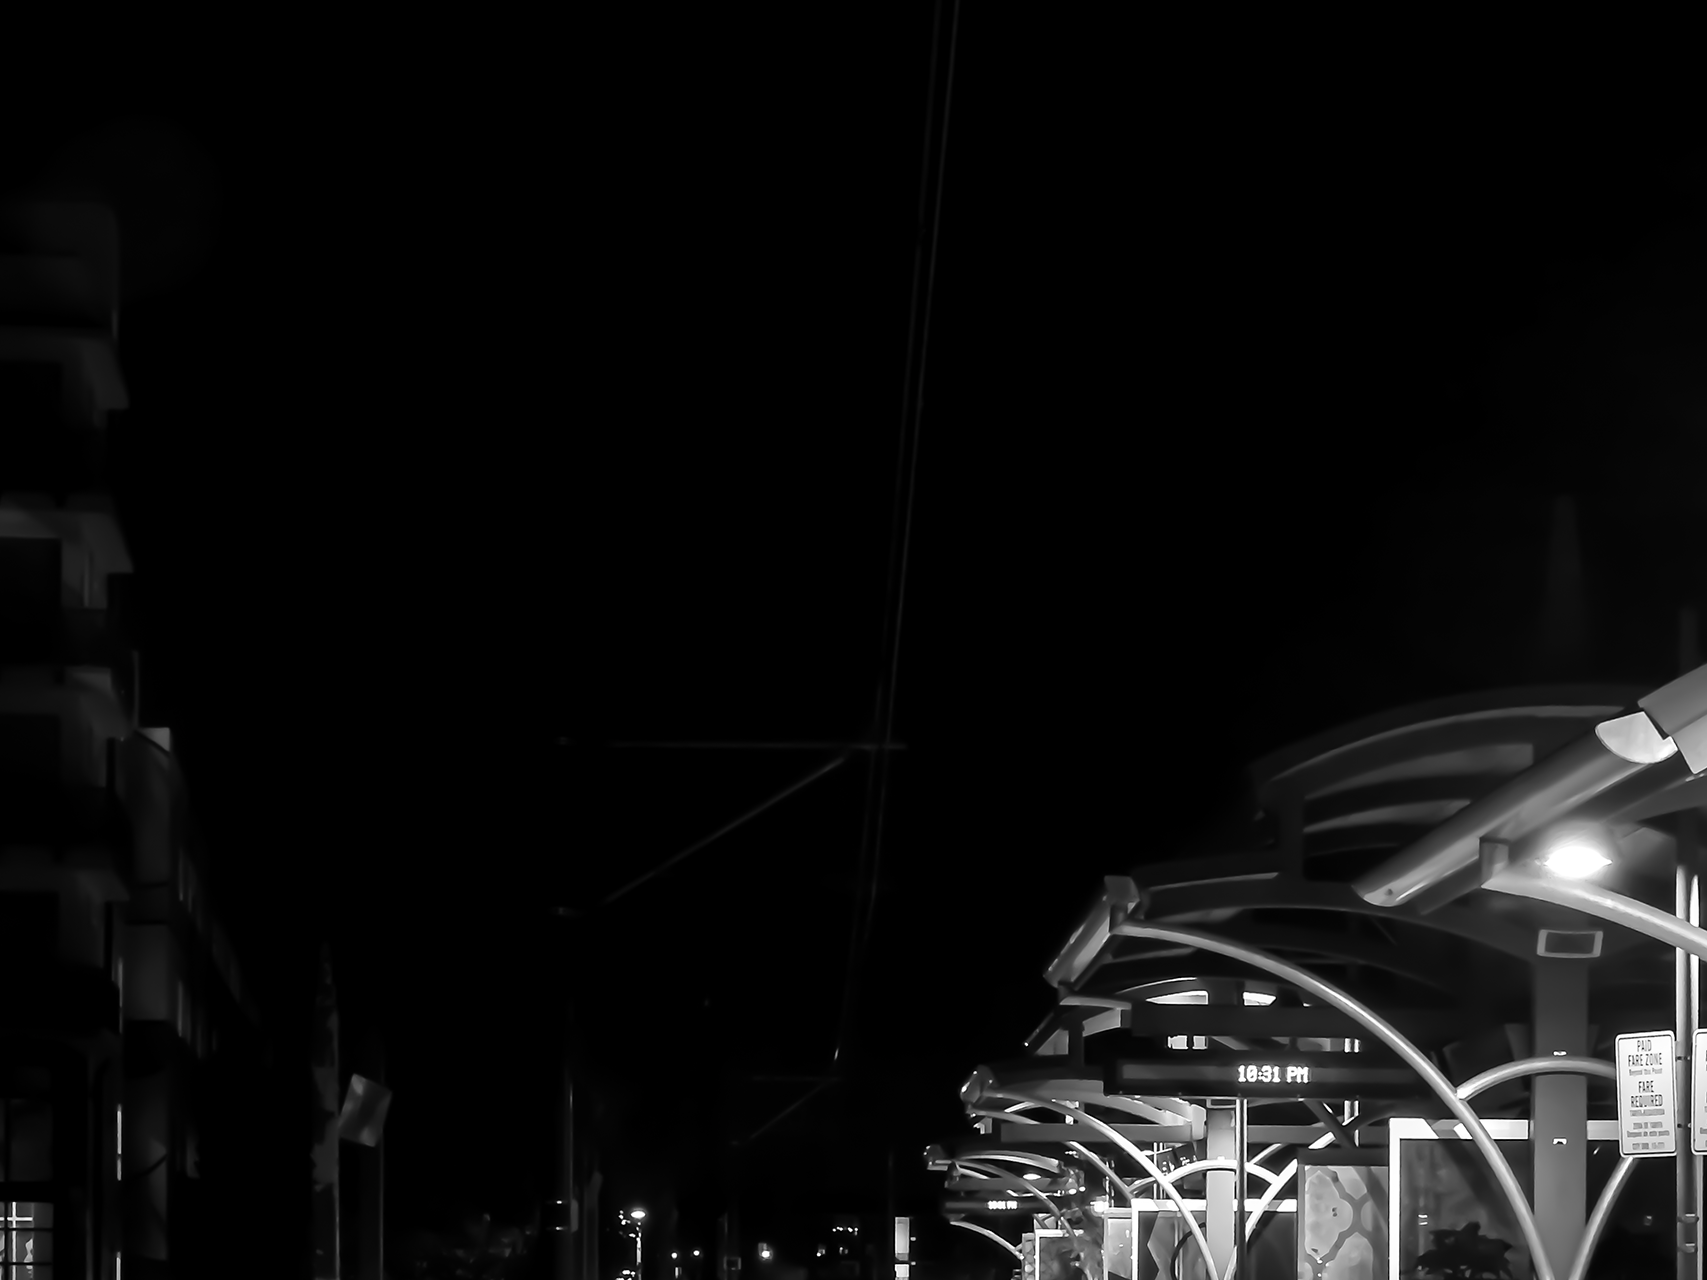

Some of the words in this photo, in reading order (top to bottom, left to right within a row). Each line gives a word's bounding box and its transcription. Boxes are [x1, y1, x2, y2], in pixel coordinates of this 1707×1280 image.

[1637, 1039, 1652, 1052] PAID
[1628, 1054, 1643, 1067] FARE
[1645, 1053, 1662, 1066] ZONE
[1238, 1065, 1281, 1083] 10:31
[1286, 1066, 1309, 1084] PM
[1638, 1081, 1654, 1093] FARE
[1631, 1094, 1663, 1108] REQRED
